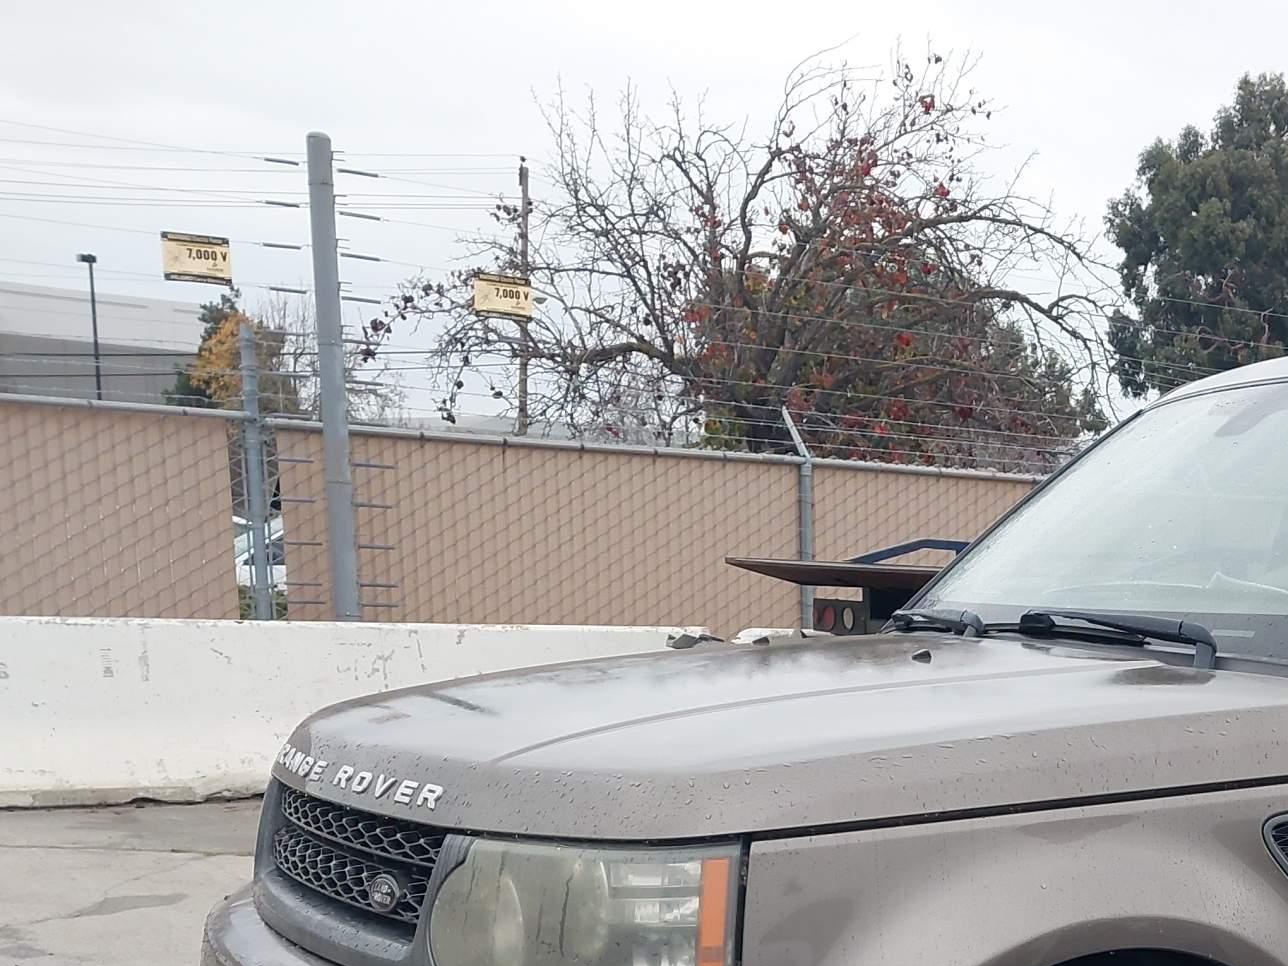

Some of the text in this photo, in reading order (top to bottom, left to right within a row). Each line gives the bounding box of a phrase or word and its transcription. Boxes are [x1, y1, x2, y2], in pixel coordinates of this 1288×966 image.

[186, 247, 228, 262] 7,000 V
[494, 287, 530, 302] 7,000 V
[333, 764, 444, 811] ROVER
